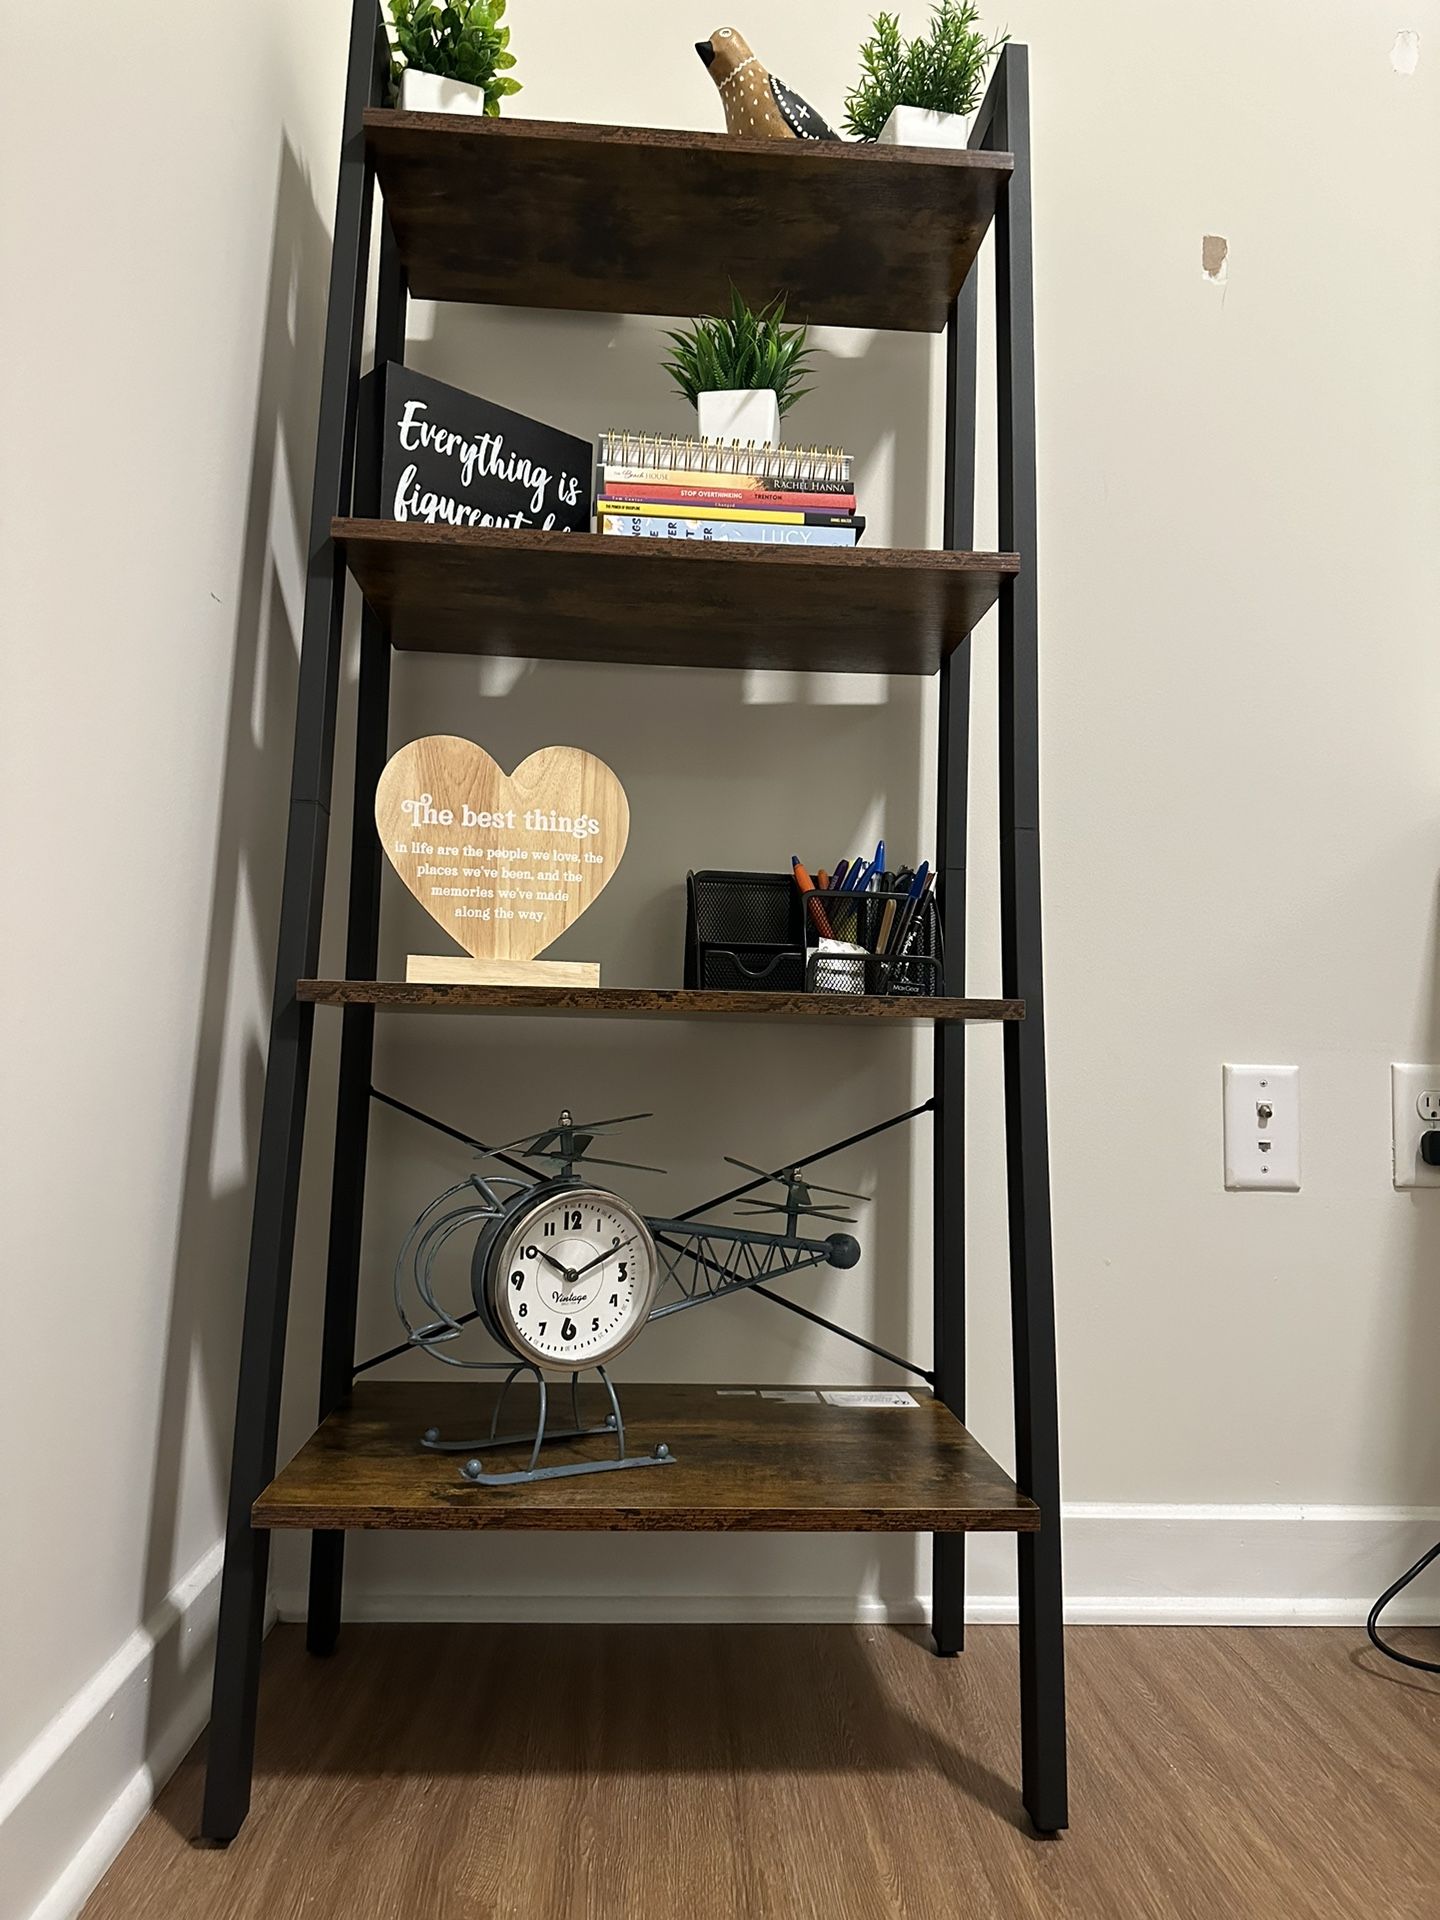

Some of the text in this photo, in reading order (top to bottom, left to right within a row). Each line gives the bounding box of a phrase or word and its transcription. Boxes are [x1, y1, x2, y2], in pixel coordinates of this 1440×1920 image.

[397, 400, 583, 513] Everything is
[645, 473, 669, 481] HOUSE
[773, 479, 846, 493] RACHEL HANNA
[680, 489, 743, 500] STOP OVERTHINKING
[754, 493, 783, 501] TRENTON
[761, 529, 813, 543] LUCY
[400, 793, 601, 839] The best things
[394, 841, 604, 864] in life are the people we love, the
[417, 863, 459, 877] places
[463, 866, 499, 878] we've
[537, 869, 560, 881] and
[563, 871, 583, 882] the
[431, 886, 570, 901] memories we've made
[455, 906, 547, 923] along the way.
[893, 984, 920, 993] MaxGear
[564, 1211, 582, 1230] 12
[597, 1219, 601, 1232] 1
[544, 1223, 555, 1236] 11
[612, 1236, 621, 1249] 2
[520, 1245, 539, 1260] 10
[617, 1262, 628, 1282] 3
[511, 1271, 525, 1291] 9
[552, 1291, 588, 1304] Vintage
[609, 1294, 618, 1307] 4
[518, 1303, 528, 1318] 8
[538, 1322, 547, 1336] 7
[561, 1317, 577, 1341] 6
[591, 1317, 600, 1331] 5
